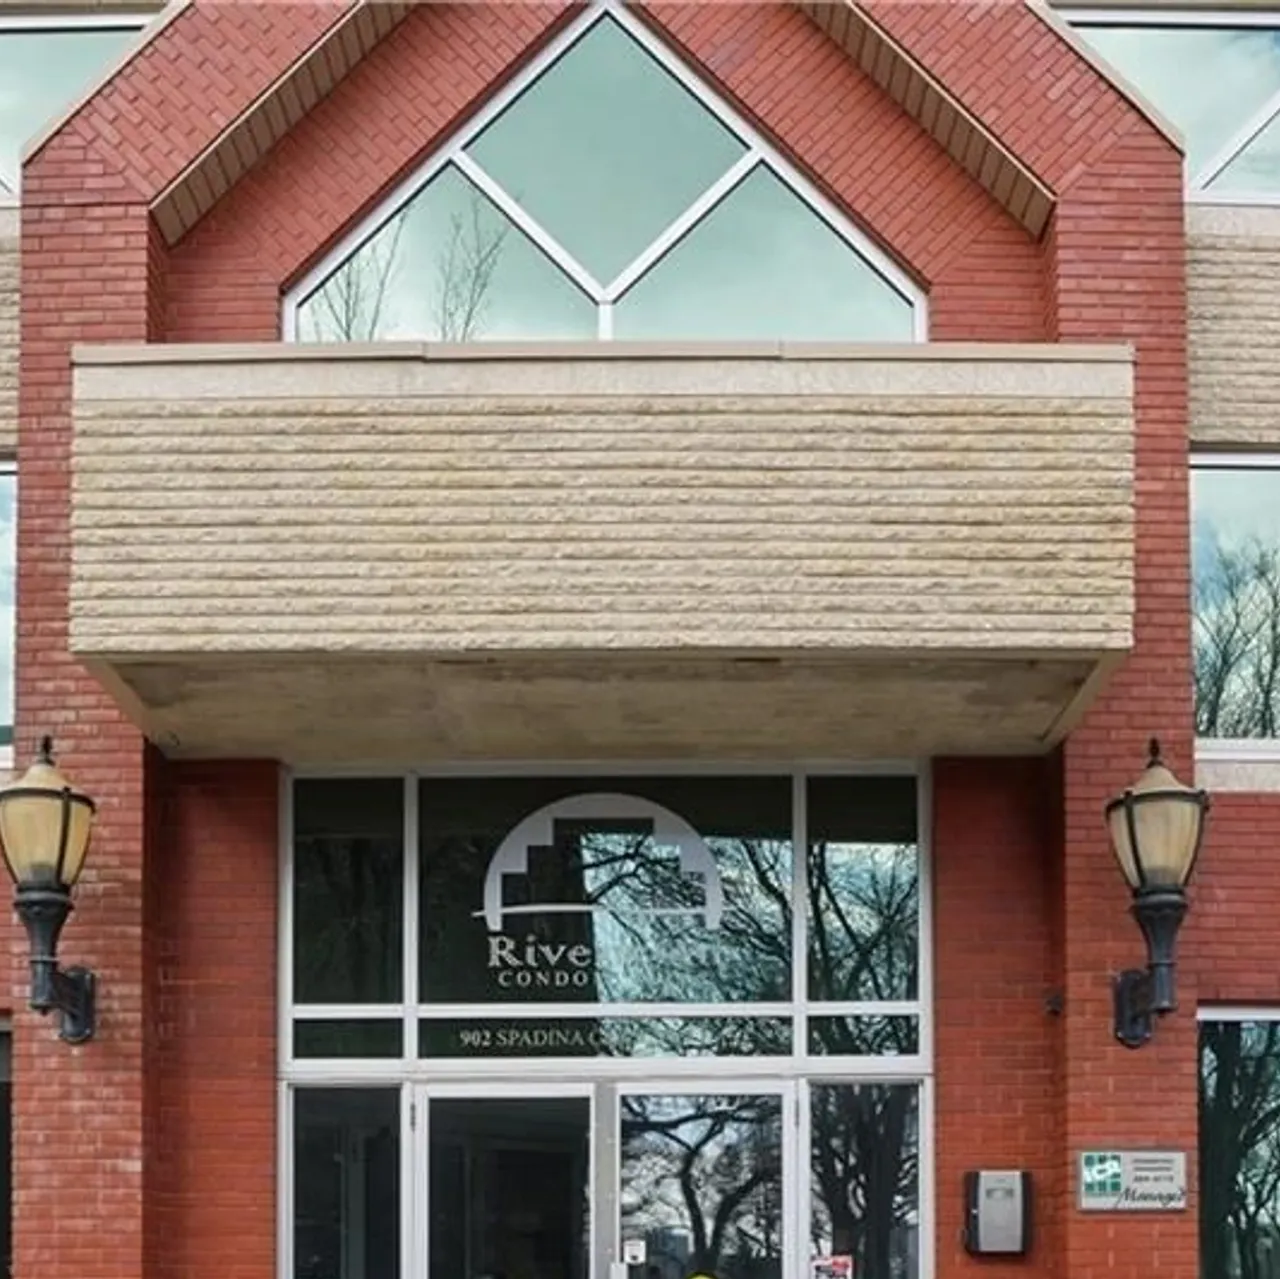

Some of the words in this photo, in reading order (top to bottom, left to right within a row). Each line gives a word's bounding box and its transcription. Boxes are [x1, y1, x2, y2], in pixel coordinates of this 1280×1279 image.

[486, 933, 593, 968] Rive
[497, 971, 589, 987] CONDO
[459, 1029, 492, 1047] 902
[495, 1028, 585, 1047] SPADINA
